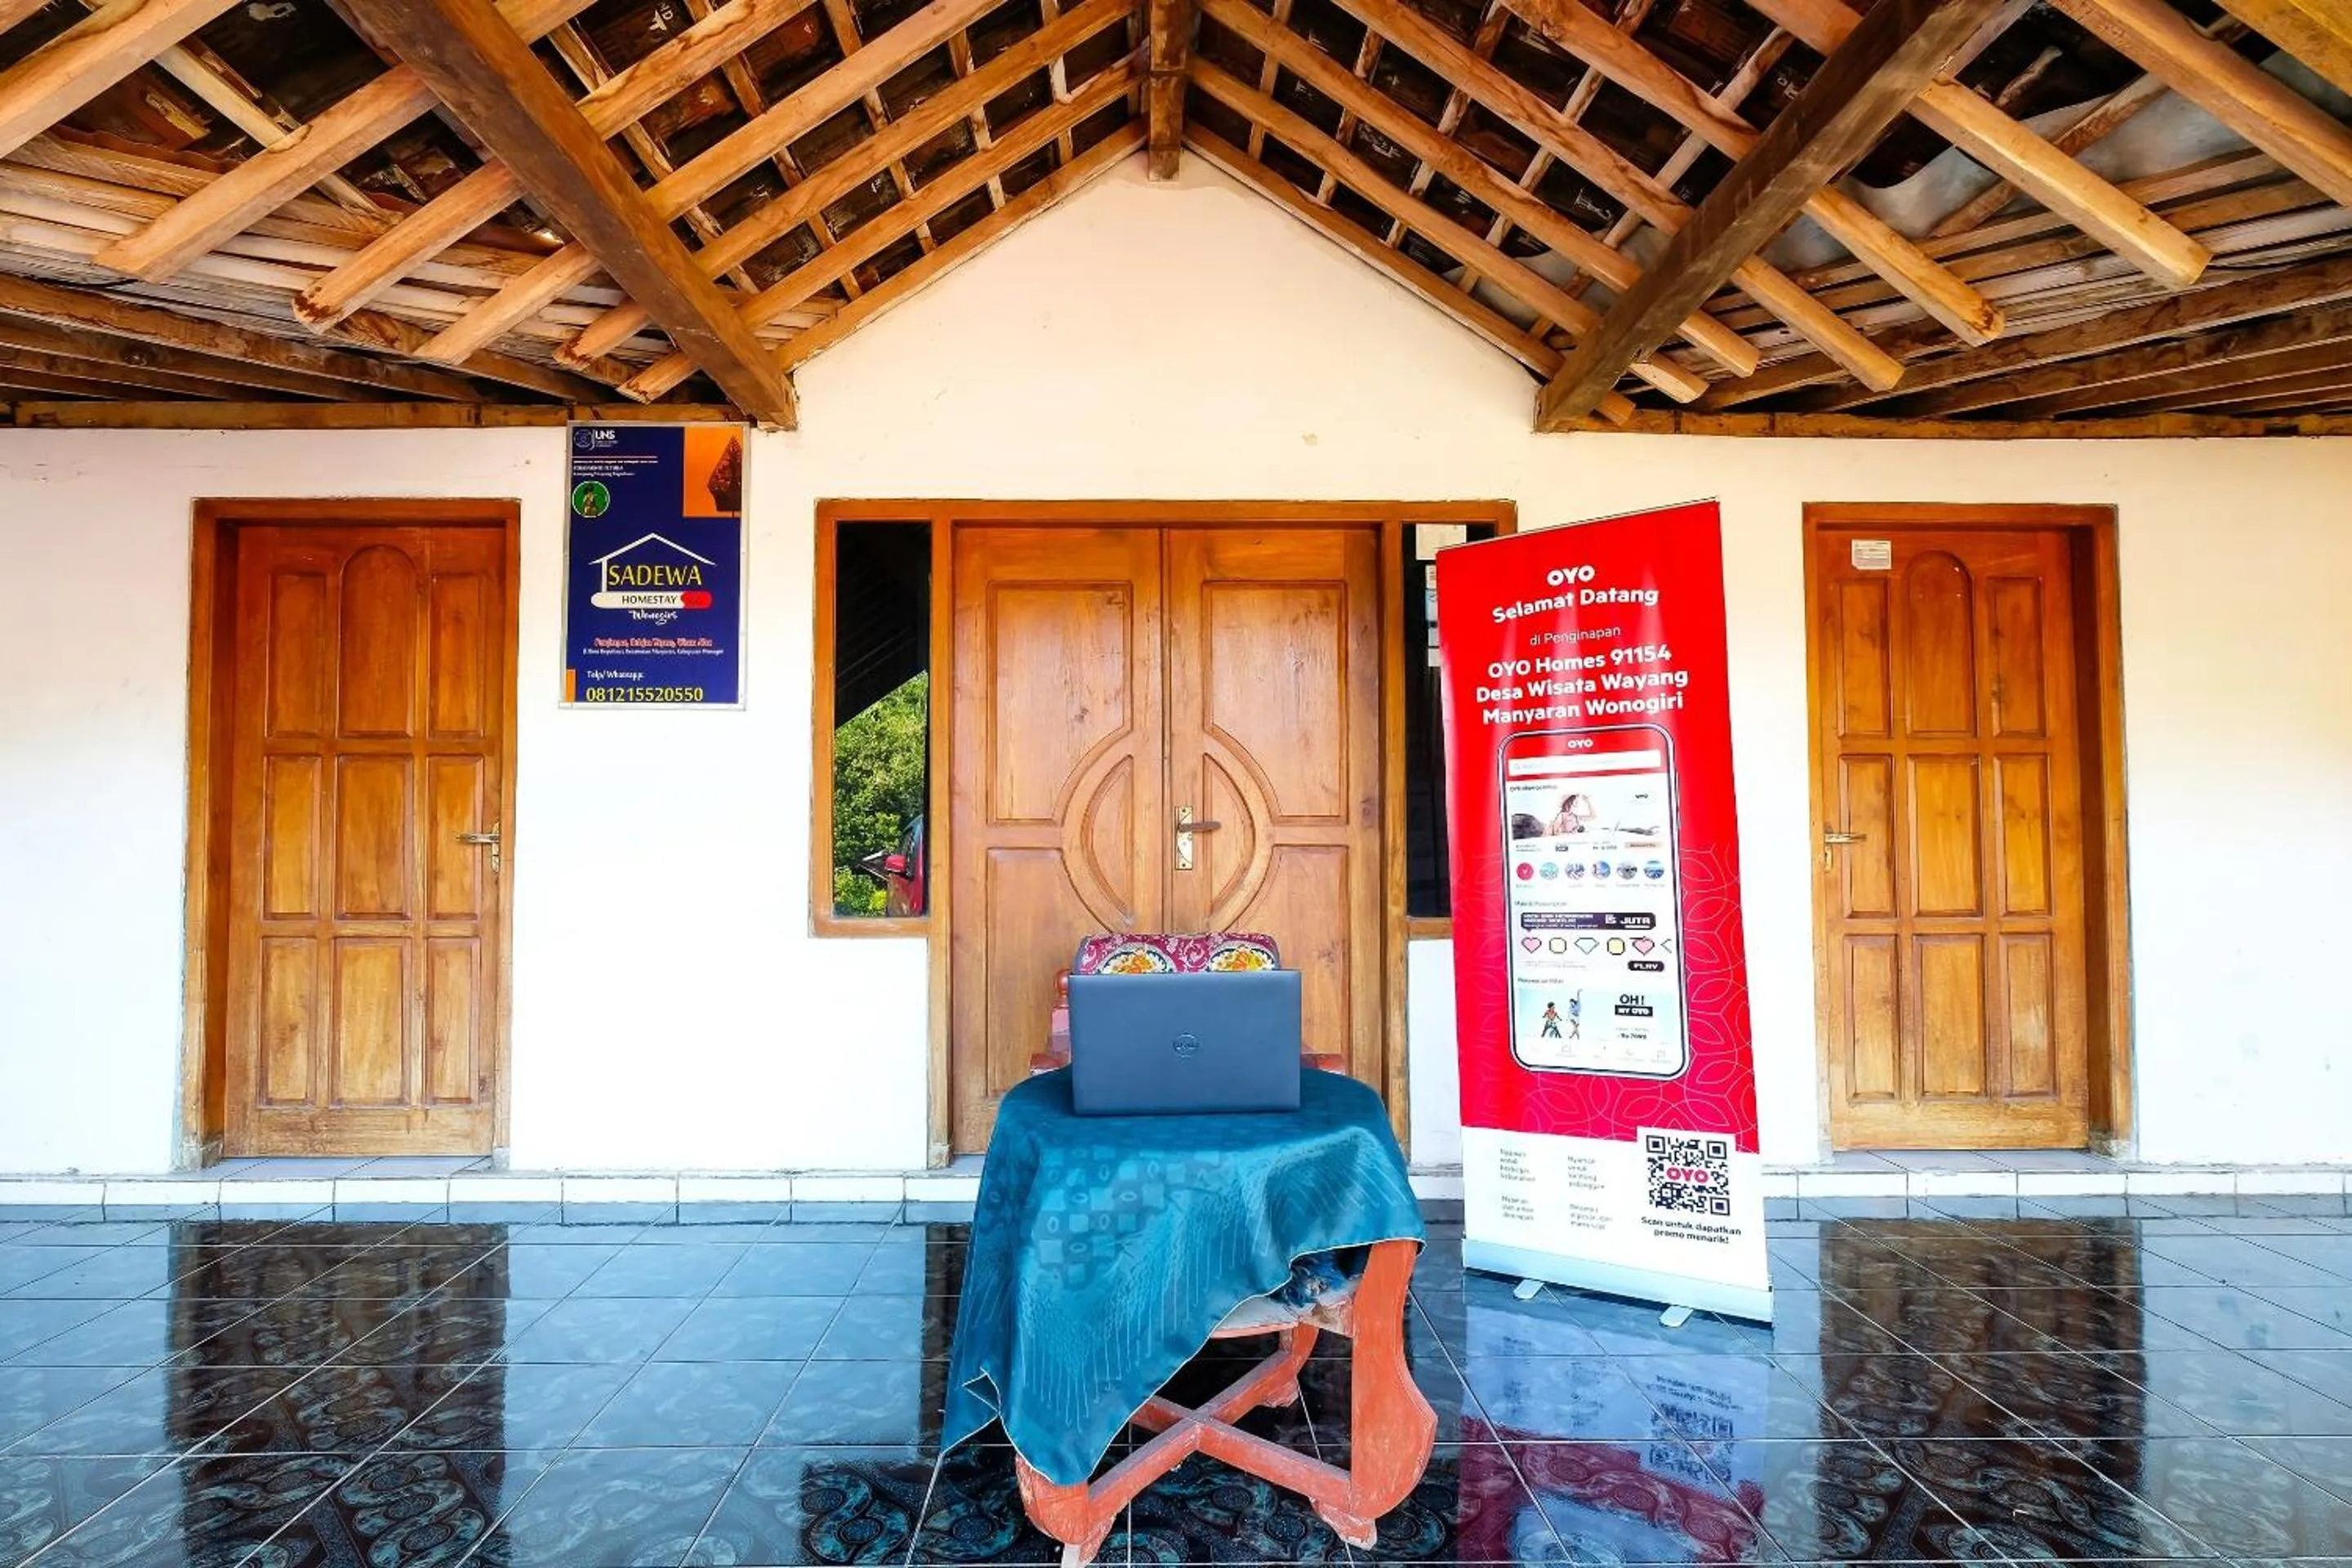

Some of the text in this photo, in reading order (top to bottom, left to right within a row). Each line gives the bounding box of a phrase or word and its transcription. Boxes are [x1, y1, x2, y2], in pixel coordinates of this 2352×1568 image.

[595, 430, 616, 439] UNS
[608, 564, 702, 586] SADEWA
[1547, 565, 1595, 586] OYO
[621, 595, 679, 604] HOMESTAY
[1493, 589, 1659, 623] Selamat Datang
[1530, 626, 1621, 645] di Penginapan
[1488, 644, 1672, 678] OYO Homes 91154
[586, 687, 703, 702] 081215520550
[1477, 670, 1688, 702] Desa Wisata Wayang
[1483, 692, 1684, 724] Manyaran Wonogiri
[1567, 738, 1593, 749] OYO
[1666, 1167, 1708, 1183] OYO
[1641, 1216, 1663, 1226] Scan
[1695, 1223, 1741, 1236] dapatkan
[1654, 1229, 1730, 1244] promo menarik!
